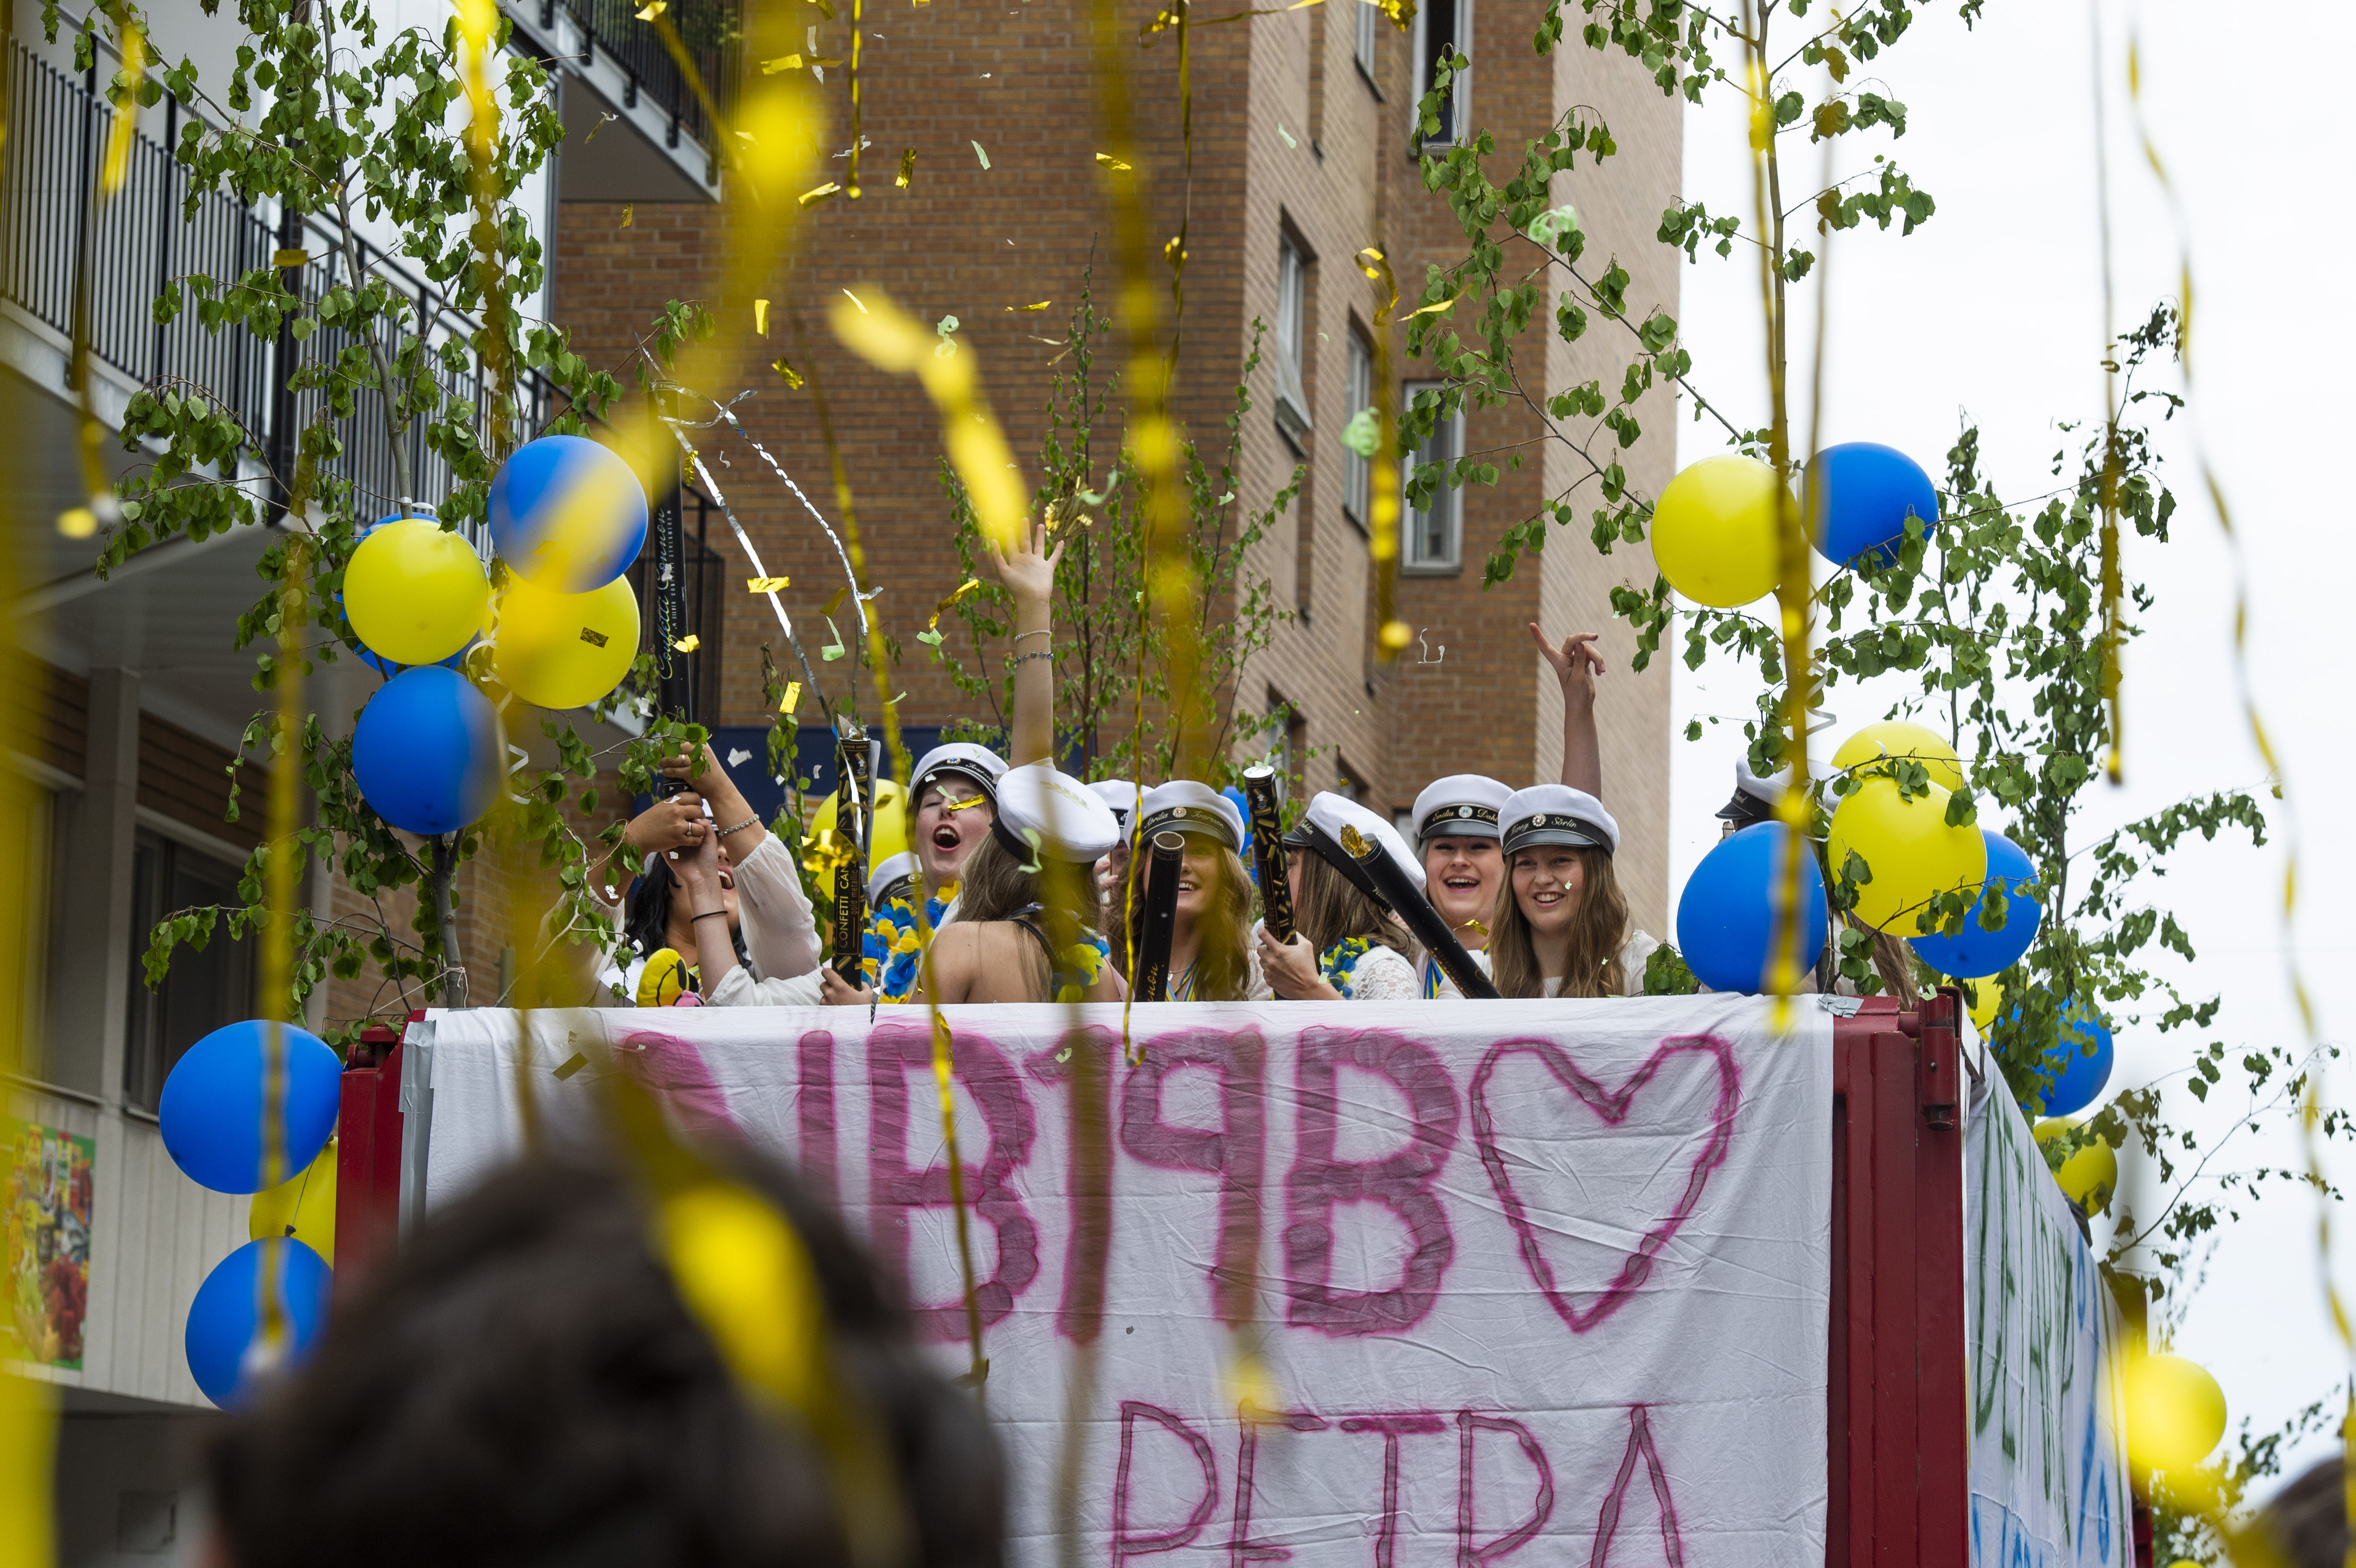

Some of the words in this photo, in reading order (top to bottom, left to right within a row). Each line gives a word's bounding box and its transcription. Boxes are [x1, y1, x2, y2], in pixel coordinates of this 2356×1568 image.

[1433, 809, 1454, 821] Emilia
[1551, 817, 1577, 828] Sörlin
[839, 896, 849, 948] CONFETTI
